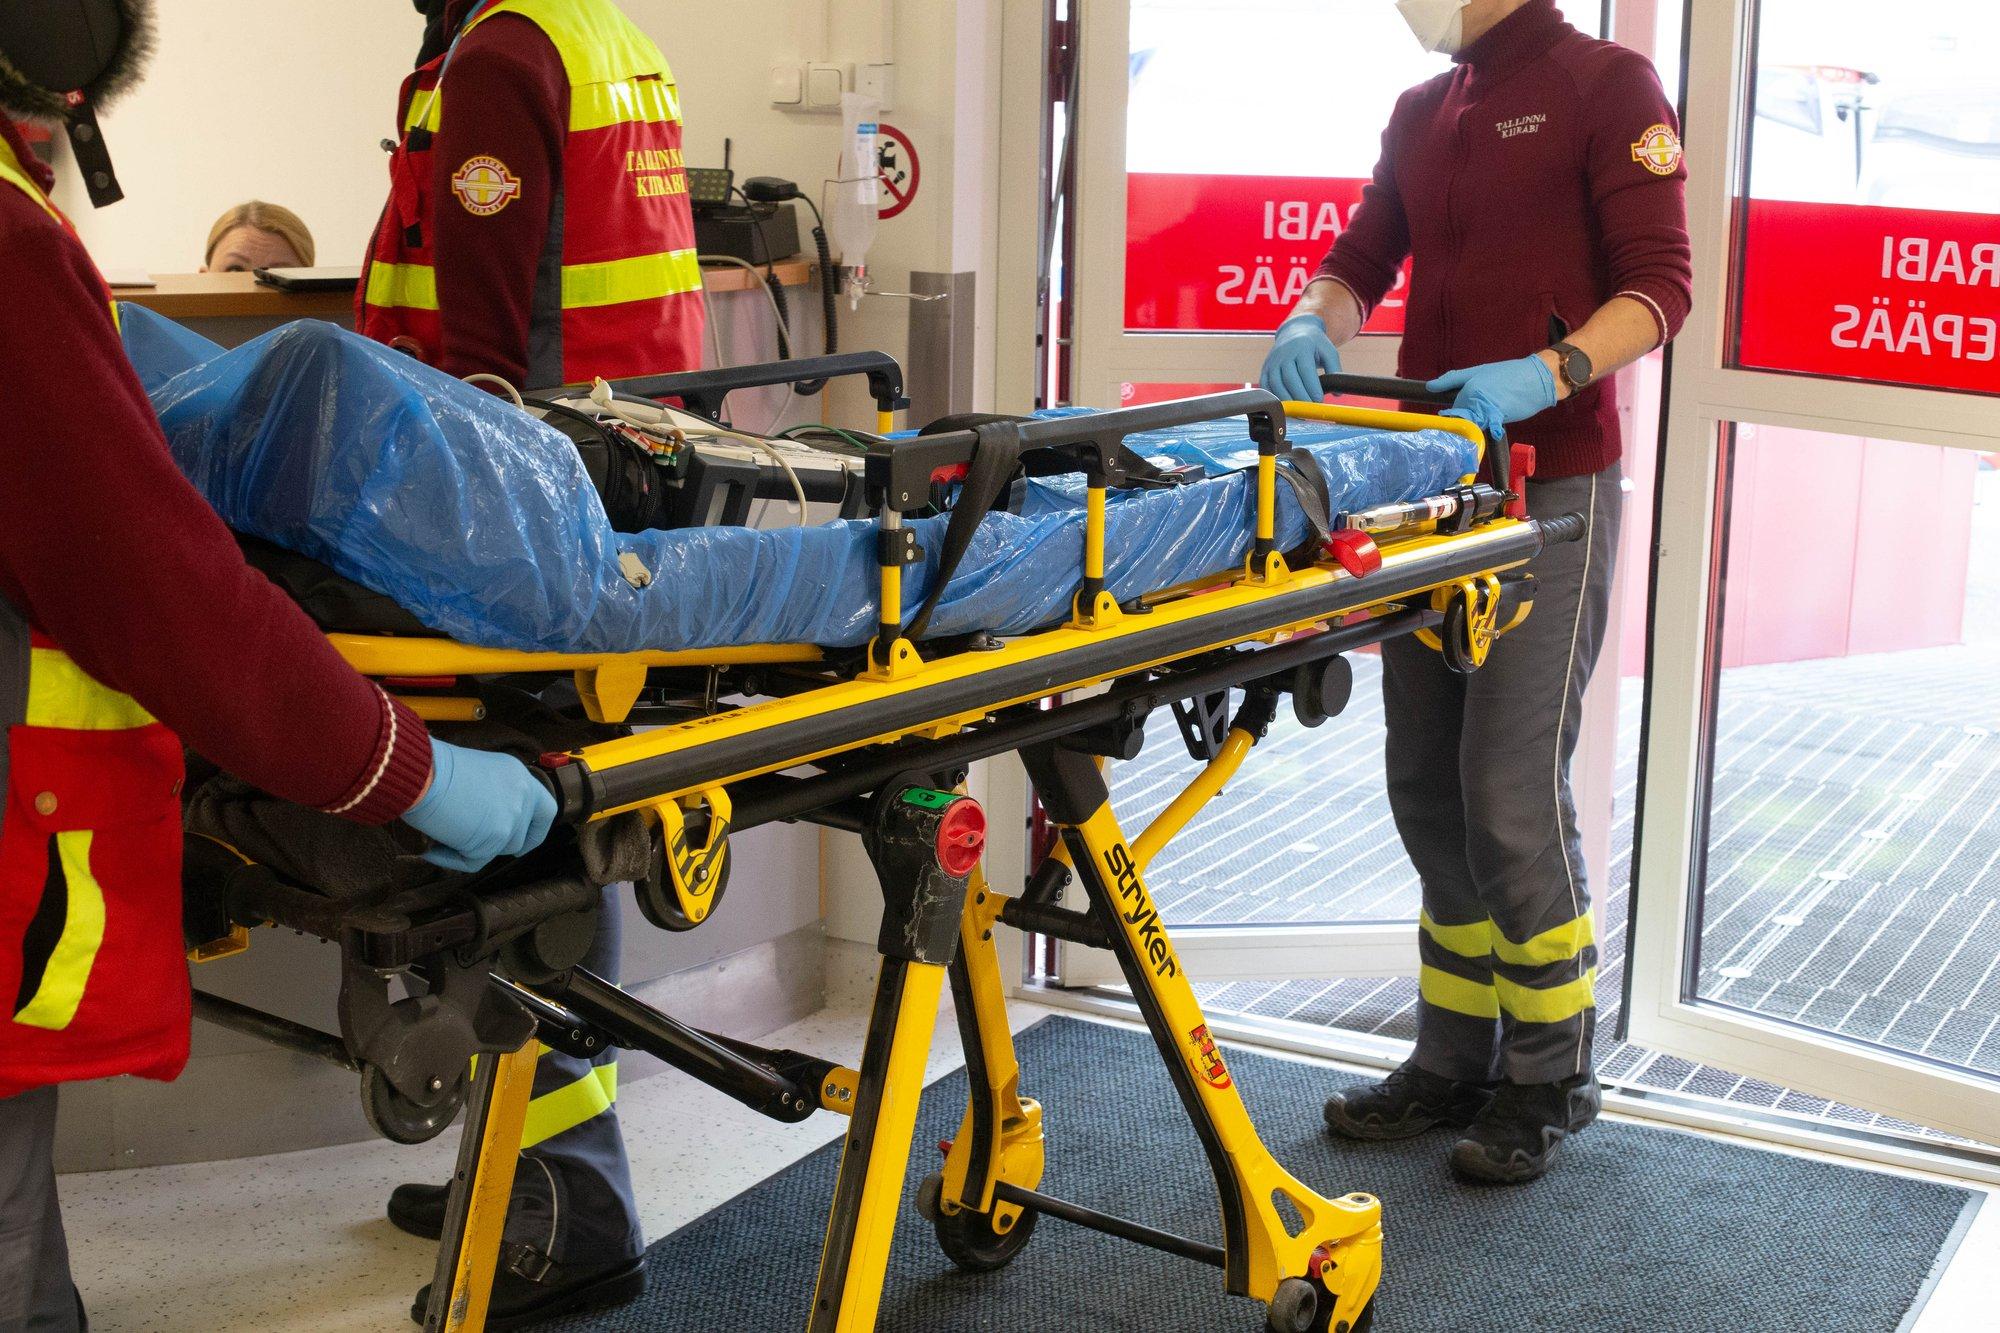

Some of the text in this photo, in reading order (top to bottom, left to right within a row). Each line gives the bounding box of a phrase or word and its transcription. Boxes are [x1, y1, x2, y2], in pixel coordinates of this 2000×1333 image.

[1495, 113, 1546, 132] TALLINNA
[1502, 124, 1539, 139] KIIRABI
[1103, 842, 1176, 979] stryker
